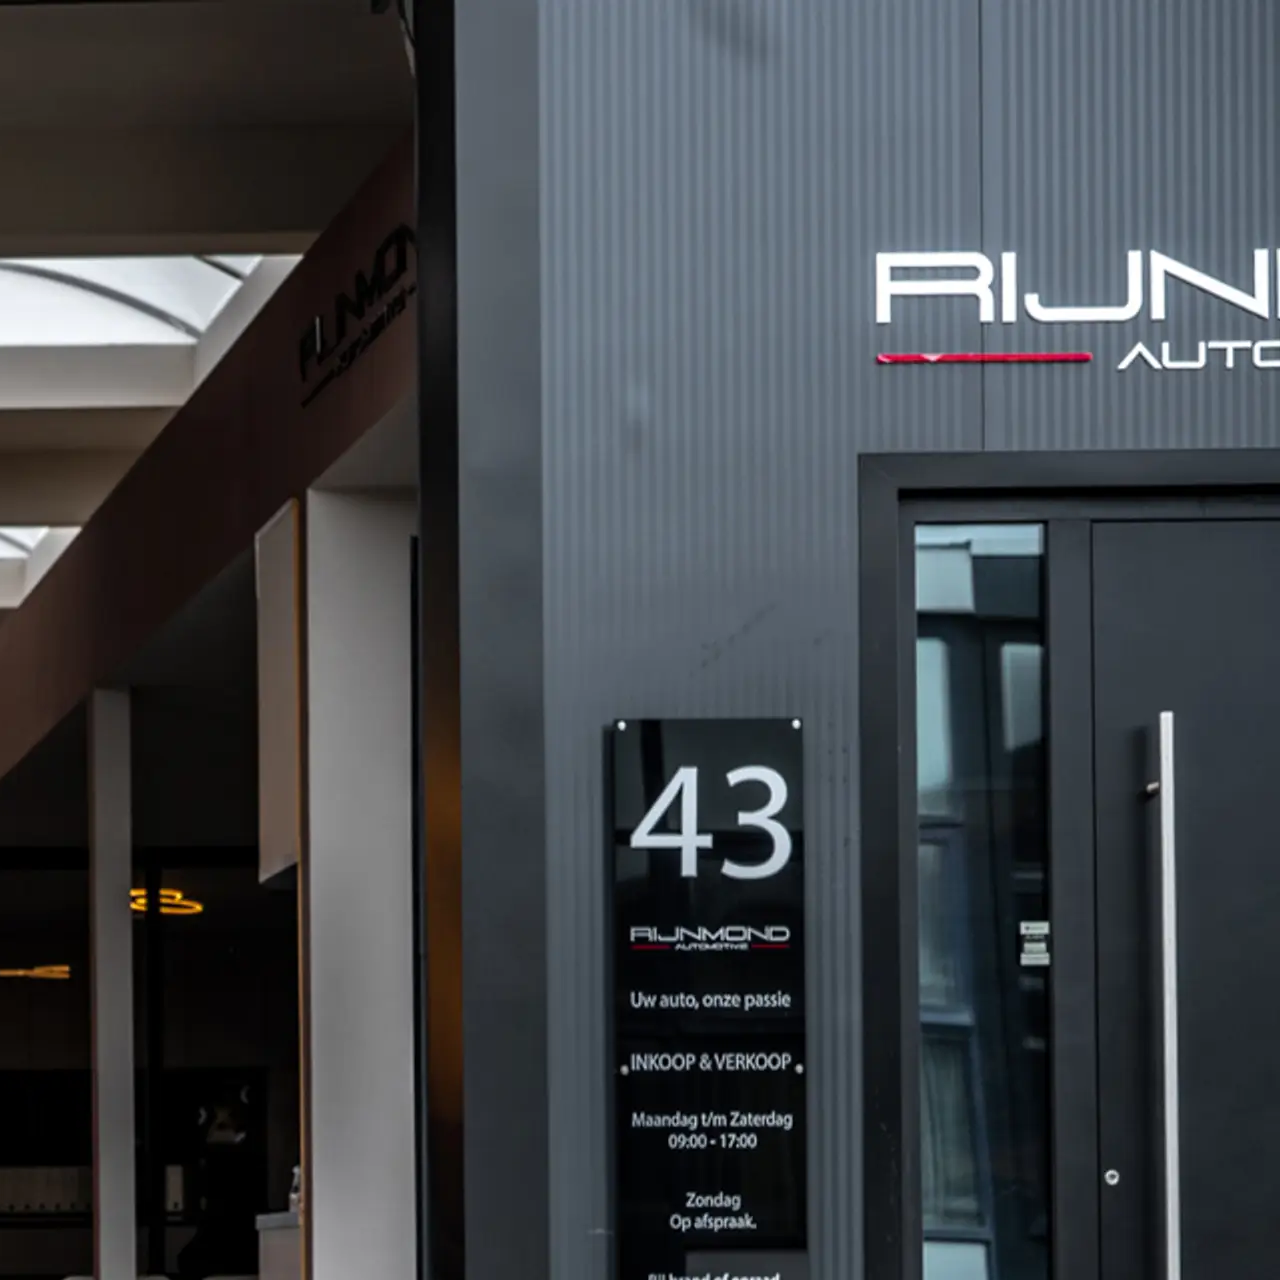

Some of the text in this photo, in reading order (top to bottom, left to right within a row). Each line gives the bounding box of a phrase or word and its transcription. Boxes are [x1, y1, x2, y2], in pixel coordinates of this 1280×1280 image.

[875, 249, 1280, 323] RIJN
[630, 765, 792, 879] 43
[629, 926, 791, 942] RIJNMOND
[674, 942, 749, 951] AUTOMOTIVE
[630, 990, 792, 1010] Uw auto, onze passie
[631, 1052, 792, 1071] INKOOP & VERKOOP
[631, 1111, 793, 1130] Maandag t/m Zaterdag
[668, 1133, 707, 1149] 09:00
[720, 1133, 757, 1149] 17:00
[686, 1191, 741, 1211] Zondag
[670, 1212, 757, 1231] Op afspraak.
